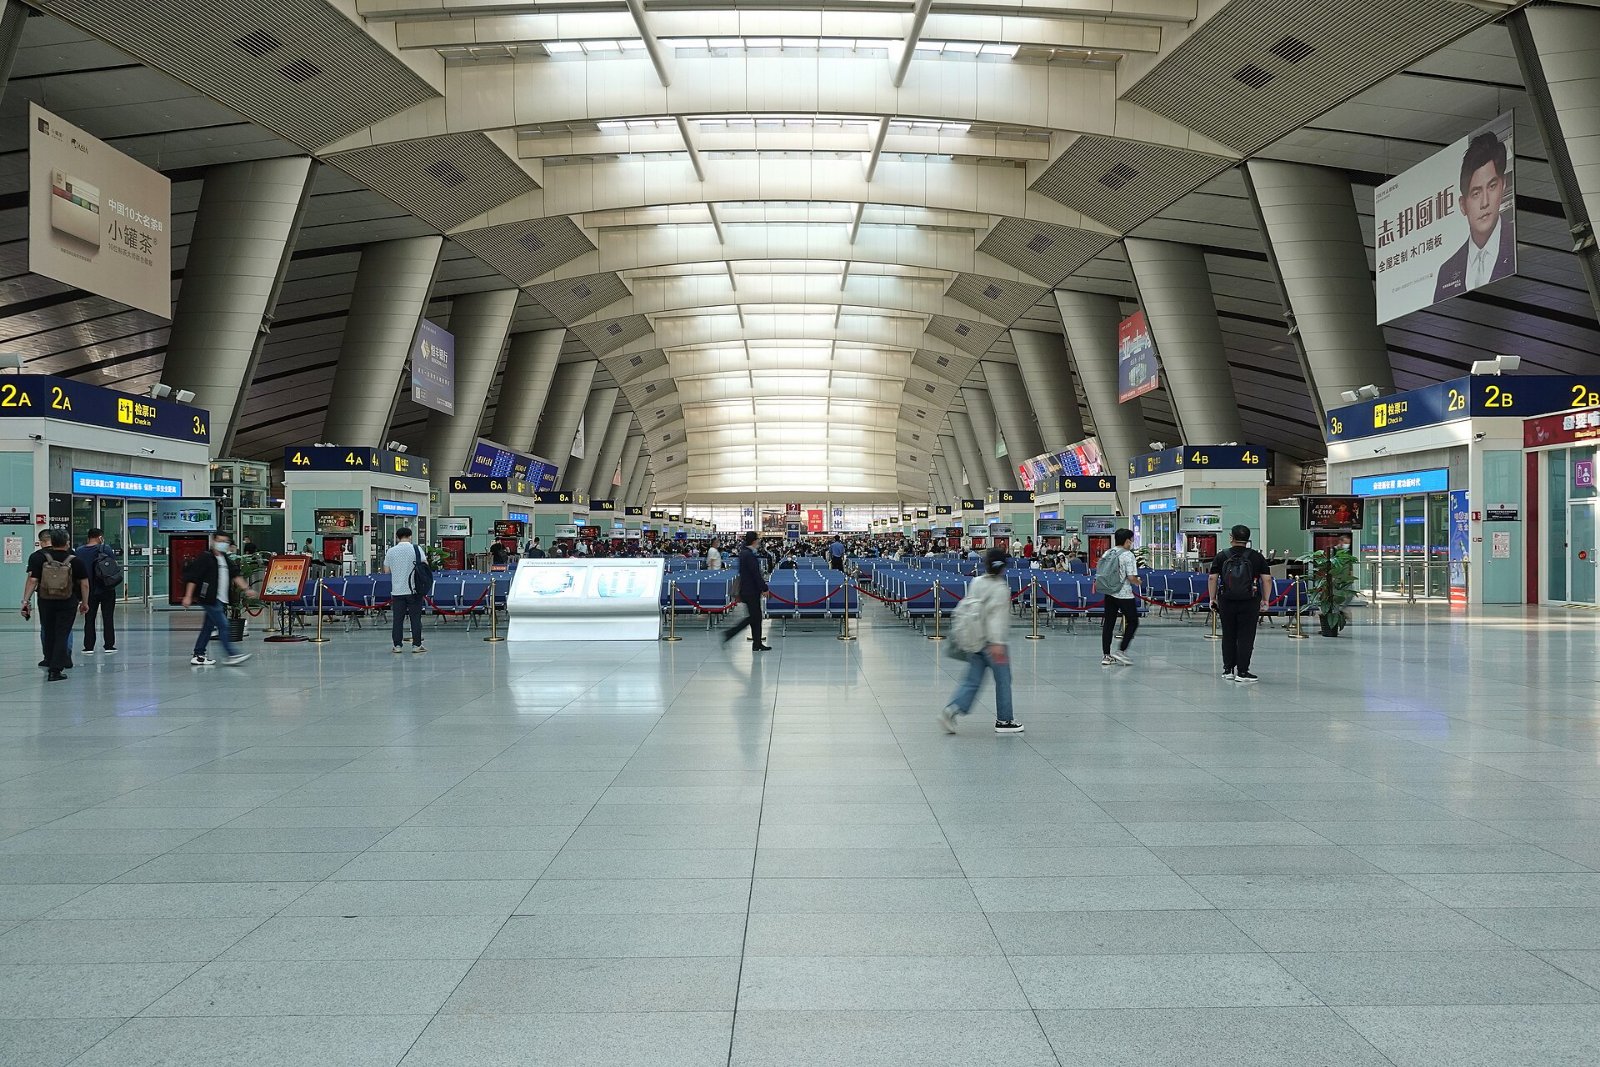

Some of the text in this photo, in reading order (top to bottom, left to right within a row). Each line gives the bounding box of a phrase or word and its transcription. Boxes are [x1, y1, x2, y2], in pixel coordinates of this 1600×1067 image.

[1378, 185, 1455, 248] 志邦厨柜
[108, 220, 152, 254] 小罐茶
[1379, 250, 1408, 273] 全屋定制
[1, 384, 32, 407] 2A
[52, 386, 72, 411] 2A
[1448, 389, 1465, 411] 2B
[1484, 385, 1513, 408] 2B
[1571, 384, 1600, 407] 2B
[134, 402, 156, 418] 检票口
[1388, 401, 1408, 416] 检票口
[193, 415, 206, 435] 3A
[1330, 417, 1343, 434] 3B
[292, 452, 311, 466] 4A
[345, 452, 363, 466] 4A
[1191, 451, 1209, 464] 4B
[1241, 451, 1259, 464] 4B
[454, 480, 467, 490] 6A
[490, 480, 502, 490] 6A
[1064, 479, 1077, 489] 6B
[1098, 479, 1111, 489] 6B
[559, 493, 569, 502] 8A
